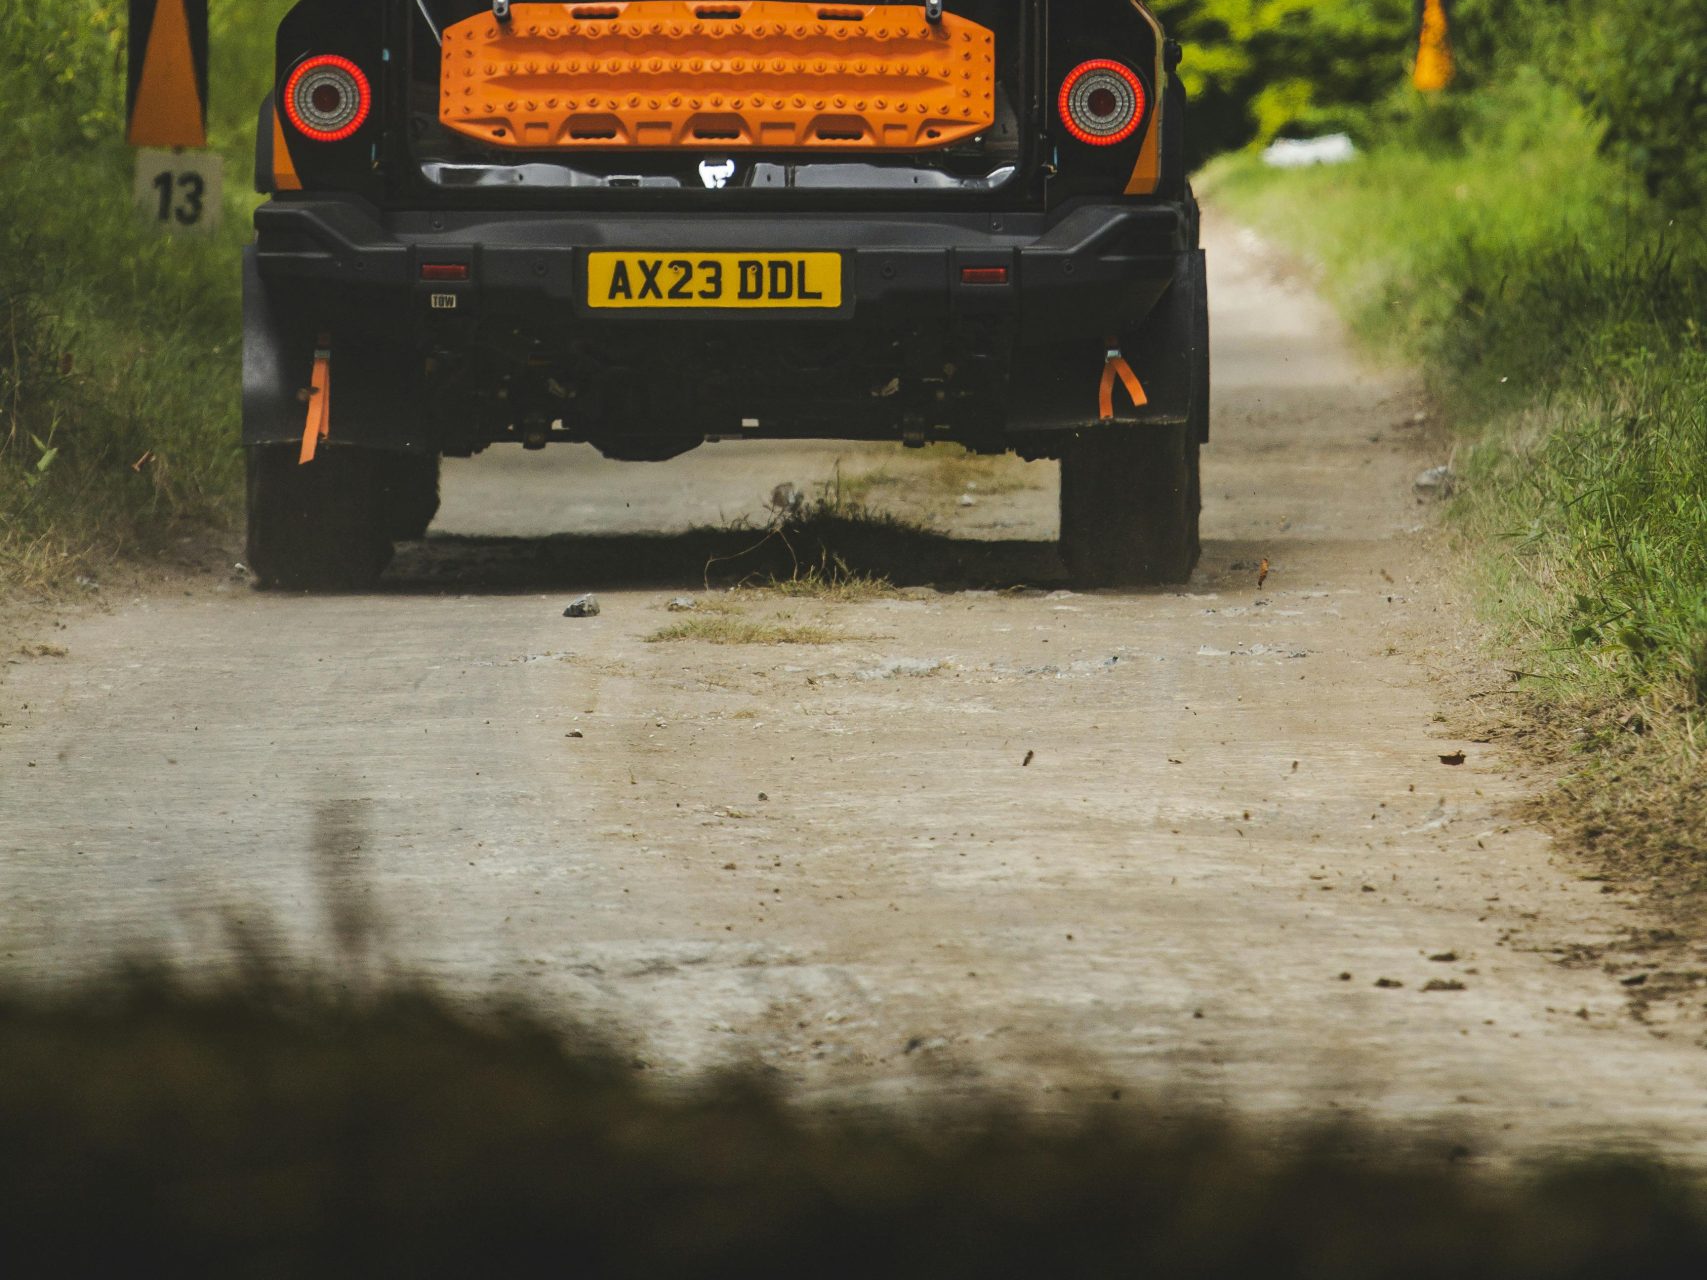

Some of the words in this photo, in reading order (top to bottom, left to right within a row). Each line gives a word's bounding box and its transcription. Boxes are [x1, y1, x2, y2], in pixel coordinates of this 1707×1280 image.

[153, 170, 204, 225] 13
[608, 260, 722, 299] AX23
[737, 260, 822, 299] DDL
[432, 295, 454, 307] TOW
